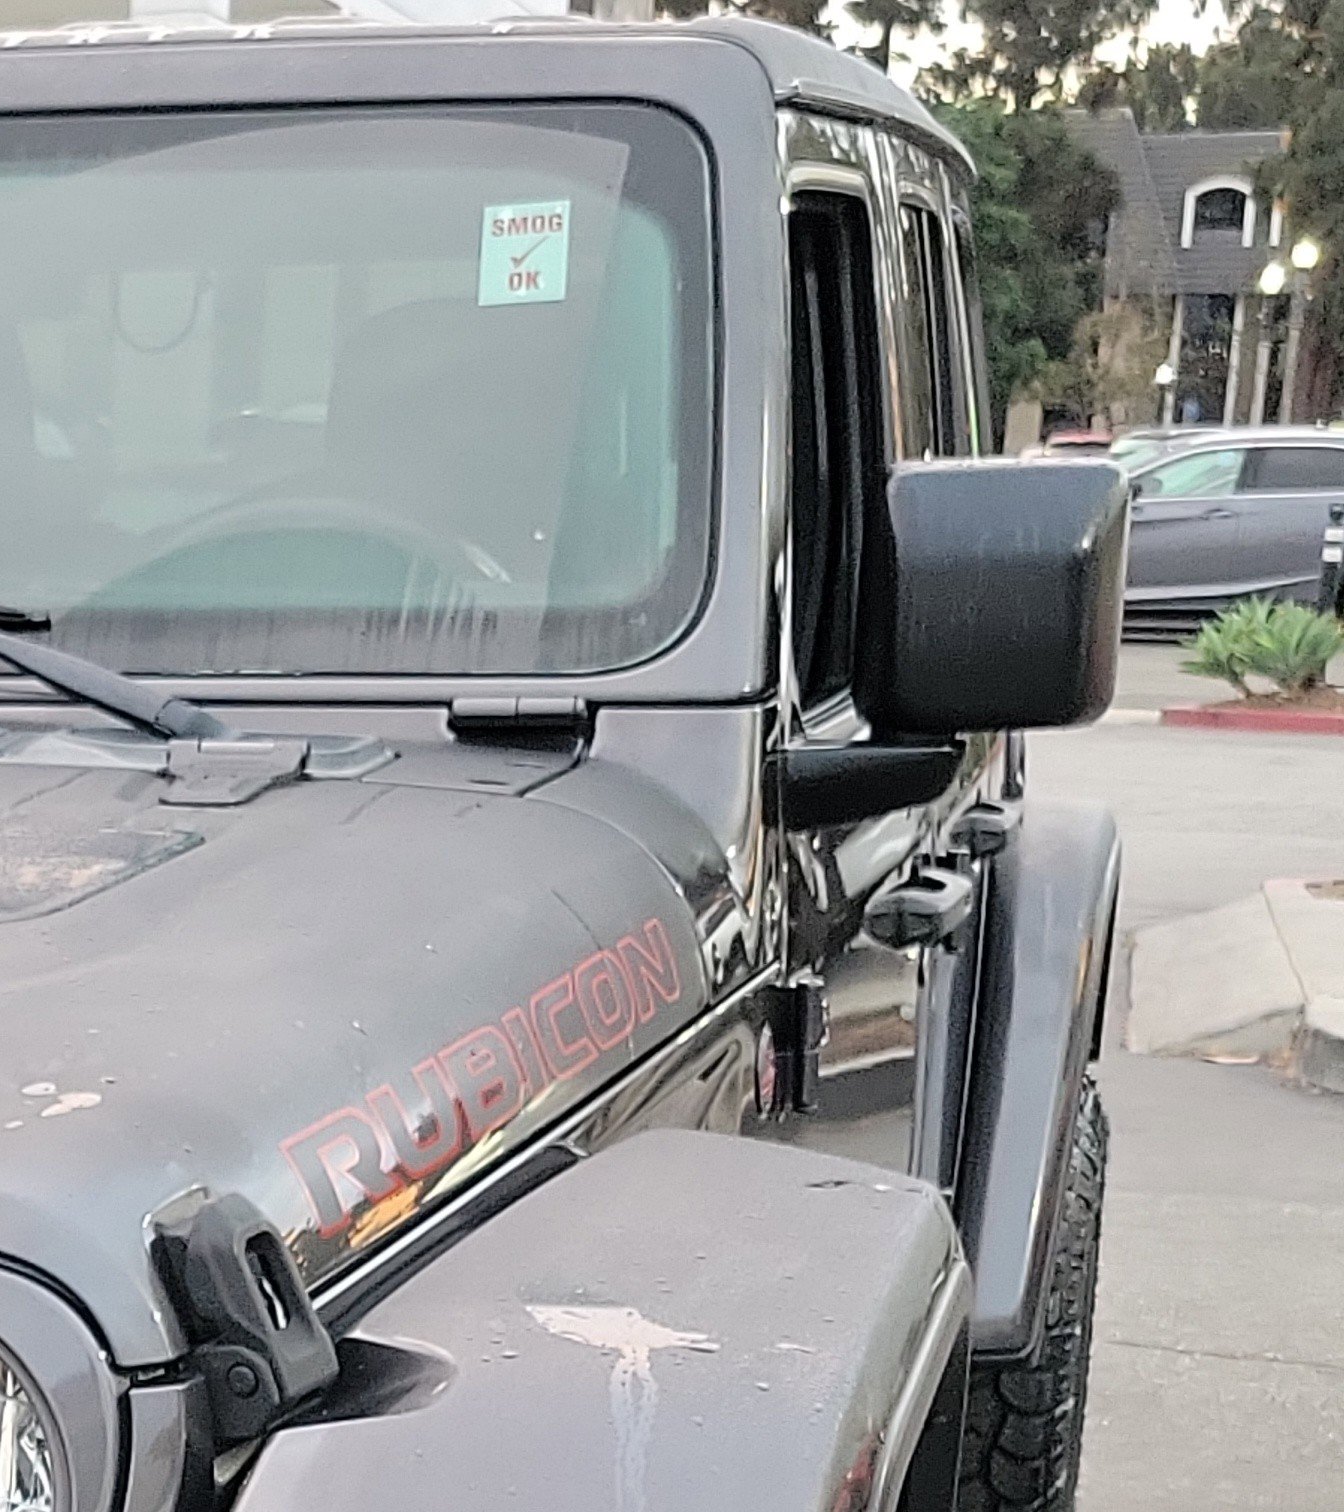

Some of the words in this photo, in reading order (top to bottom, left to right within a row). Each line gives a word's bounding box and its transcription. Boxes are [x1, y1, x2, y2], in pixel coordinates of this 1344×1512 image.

[491, 213, 563, 237] SMOG
[508, 271, 541, 292] OK
[278, 918, 682, 1240] RUBICON
